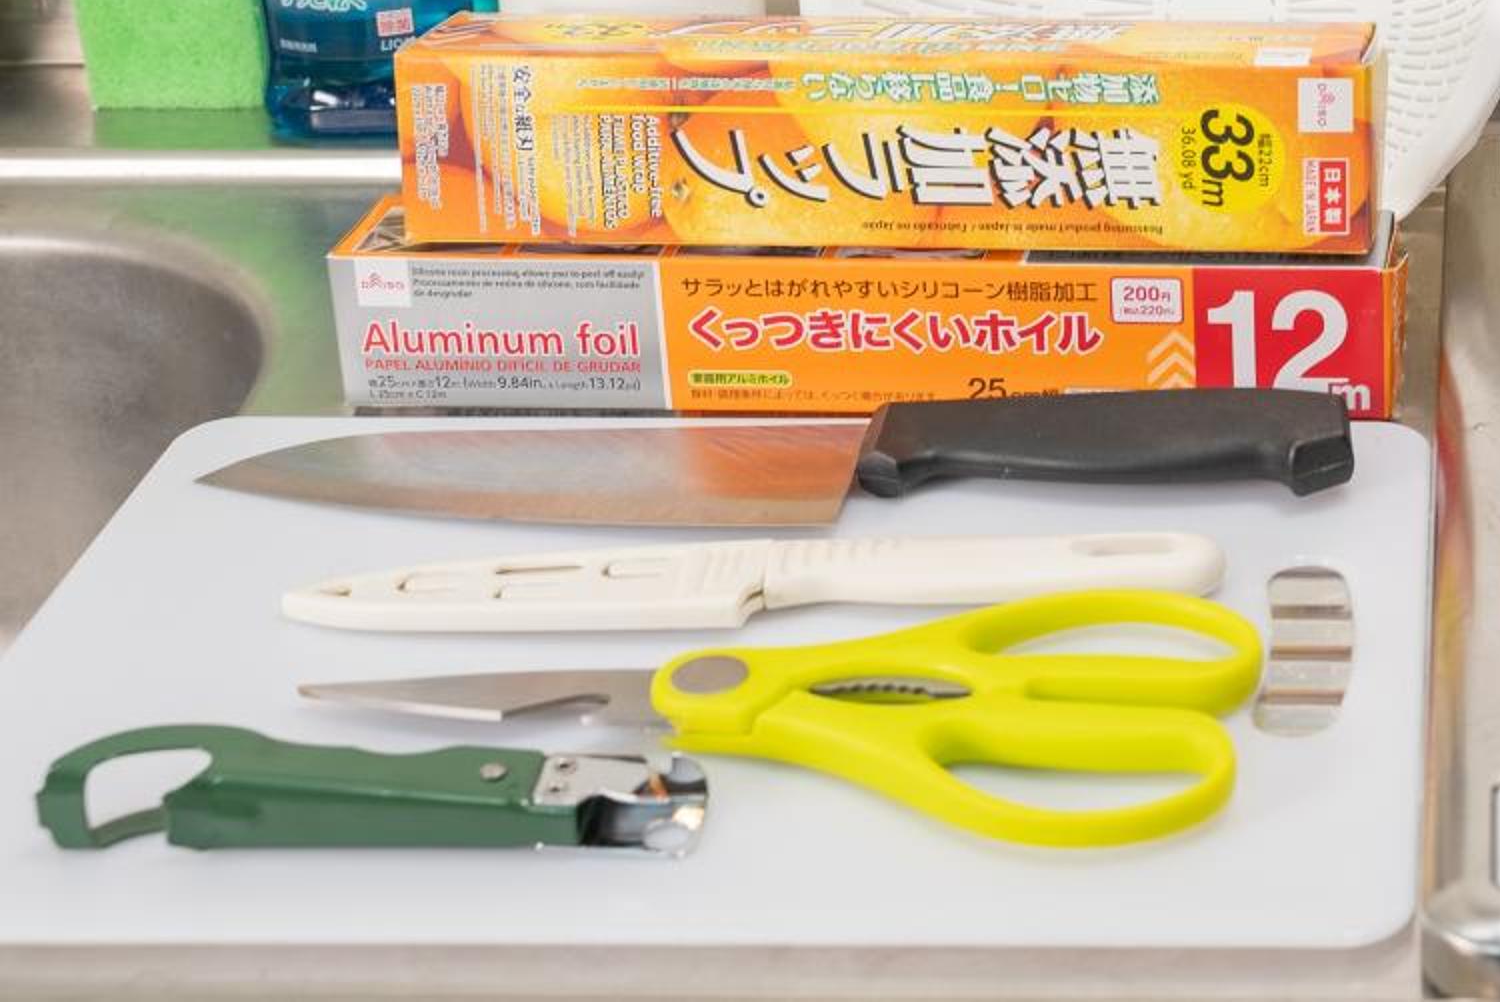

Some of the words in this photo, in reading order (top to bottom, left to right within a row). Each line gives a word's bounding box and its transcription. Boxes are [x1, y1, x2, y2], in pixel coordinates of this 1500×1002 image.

[380, 38, 404, 52] LIO
[630, 115, 646, 151] food
[630, 152, 647, 194] wrap
[670, 126, 1162, 209] 無添加ラップ
[681, 277, 1098, 302] サラッとはがれやすいシリコーン樹脂加工
[1123, 285, 1171, 302] 200円
[362, 321, 564, 356] Aluminum
[576, 321, 641, 356] foil
[689, 307, 1103, 354] くっつきにくいホイル
[365, 359, 412, 372] PAPEL
[553, 360, 573, 374] DE
[576, 360, 642, 374] GRUDAR
